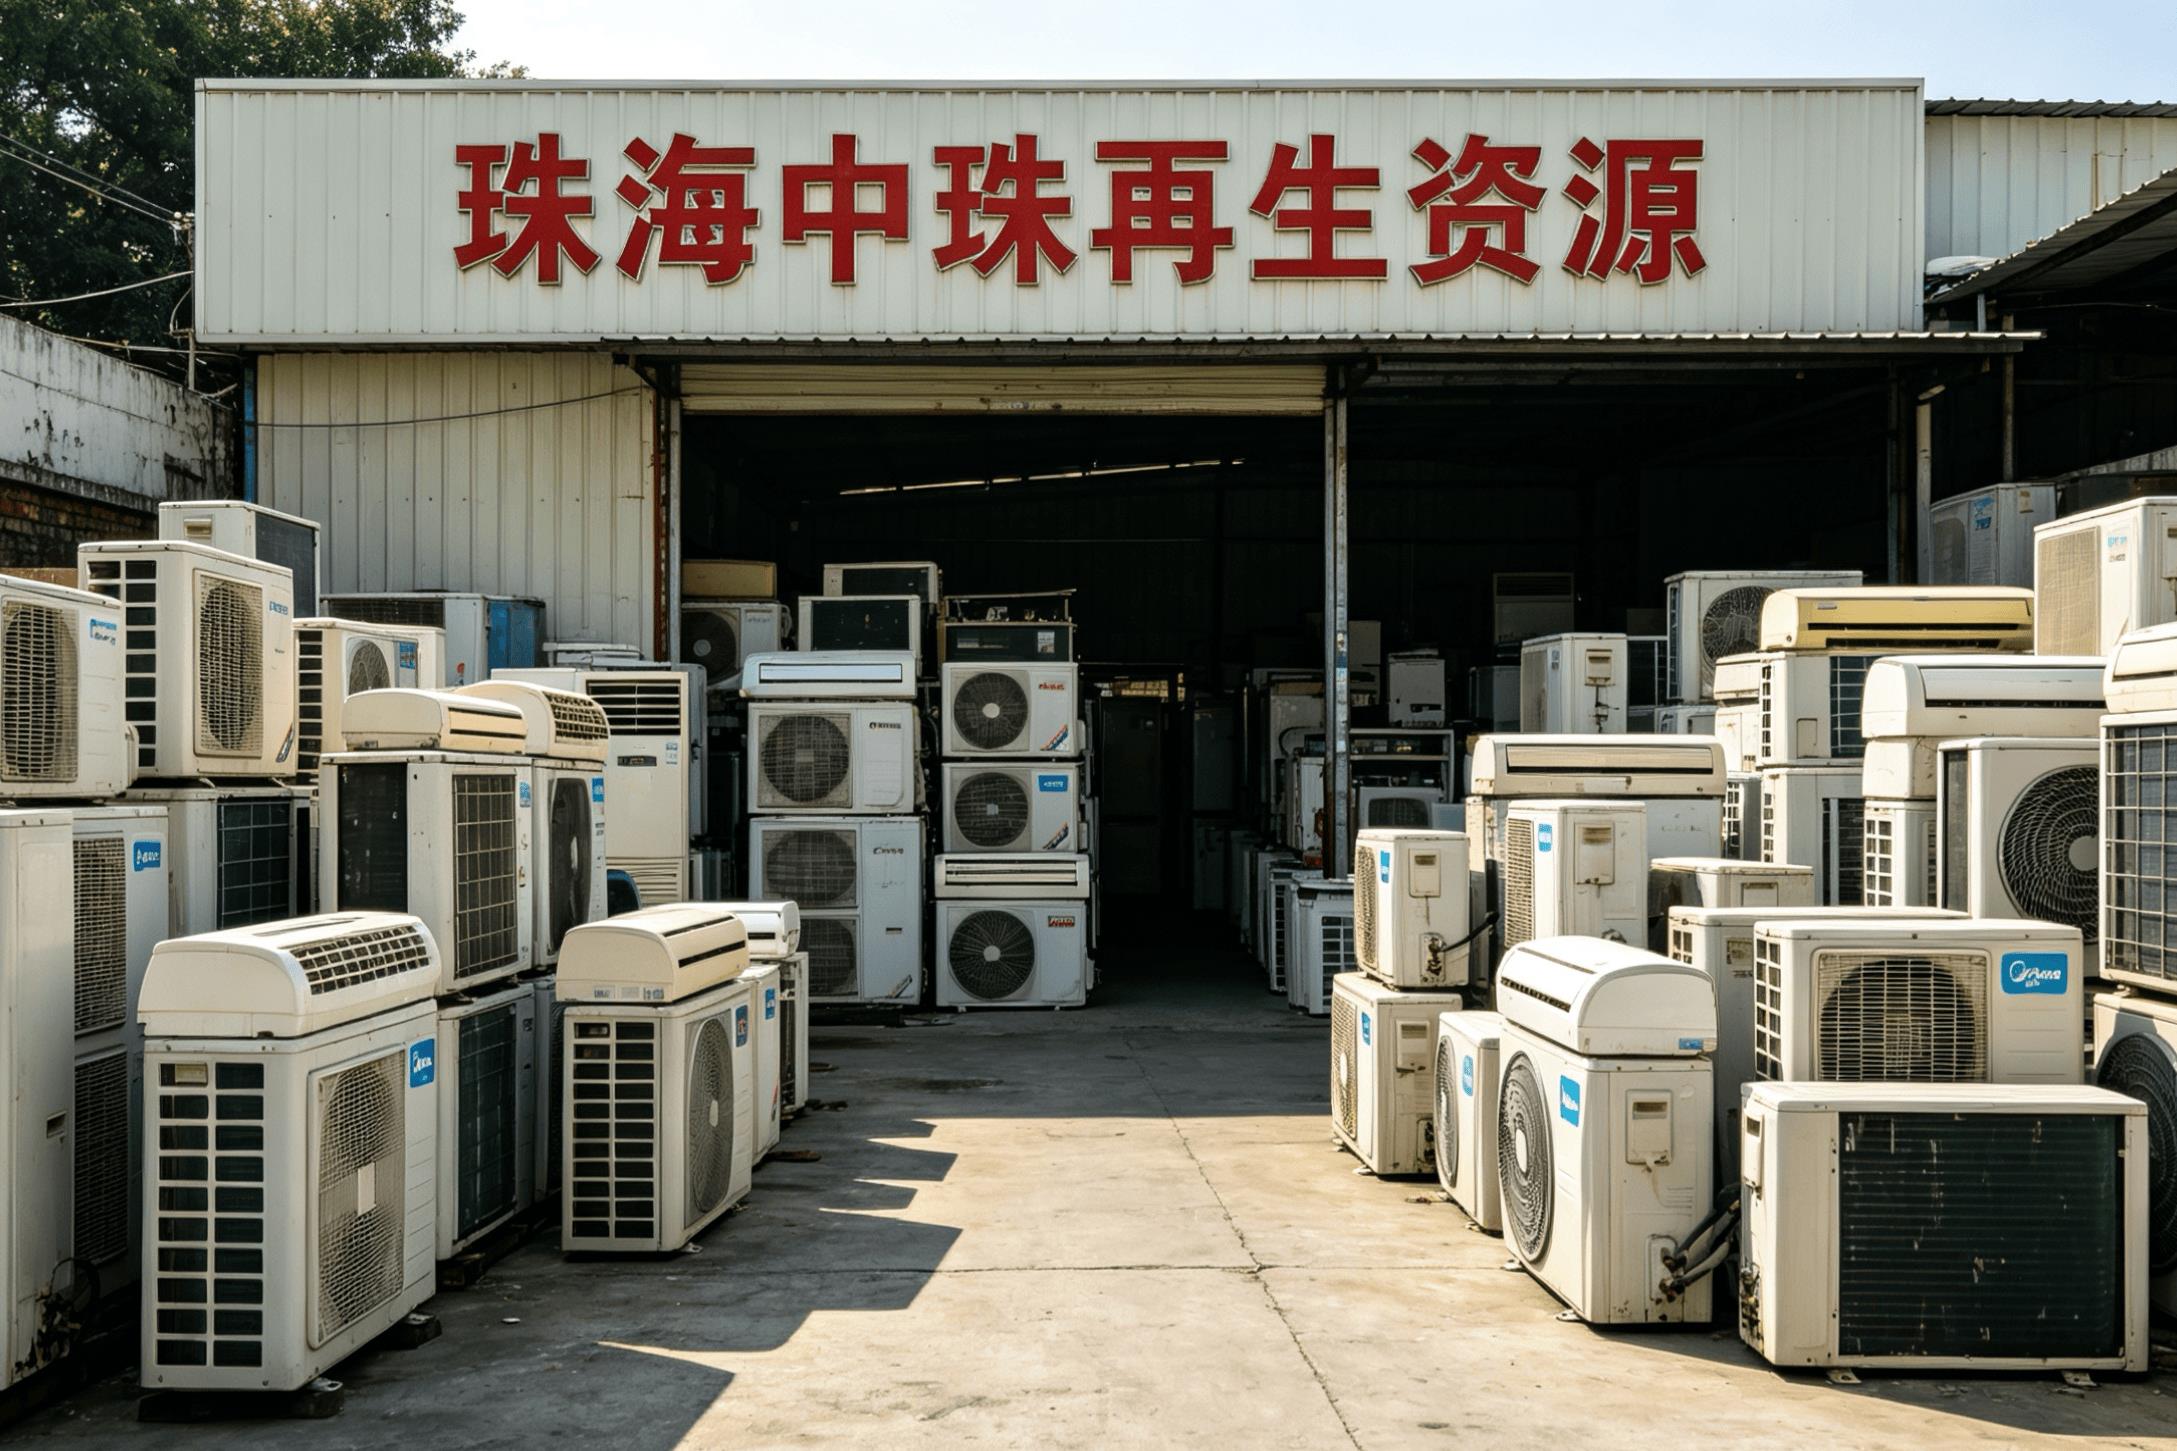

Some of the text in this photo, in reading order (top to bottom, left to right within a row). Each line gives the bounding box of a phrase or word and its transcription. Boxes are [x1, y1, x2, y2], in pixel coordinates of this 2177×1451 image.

[455, 133, 1705, 285] 珠海中珠再生资源
